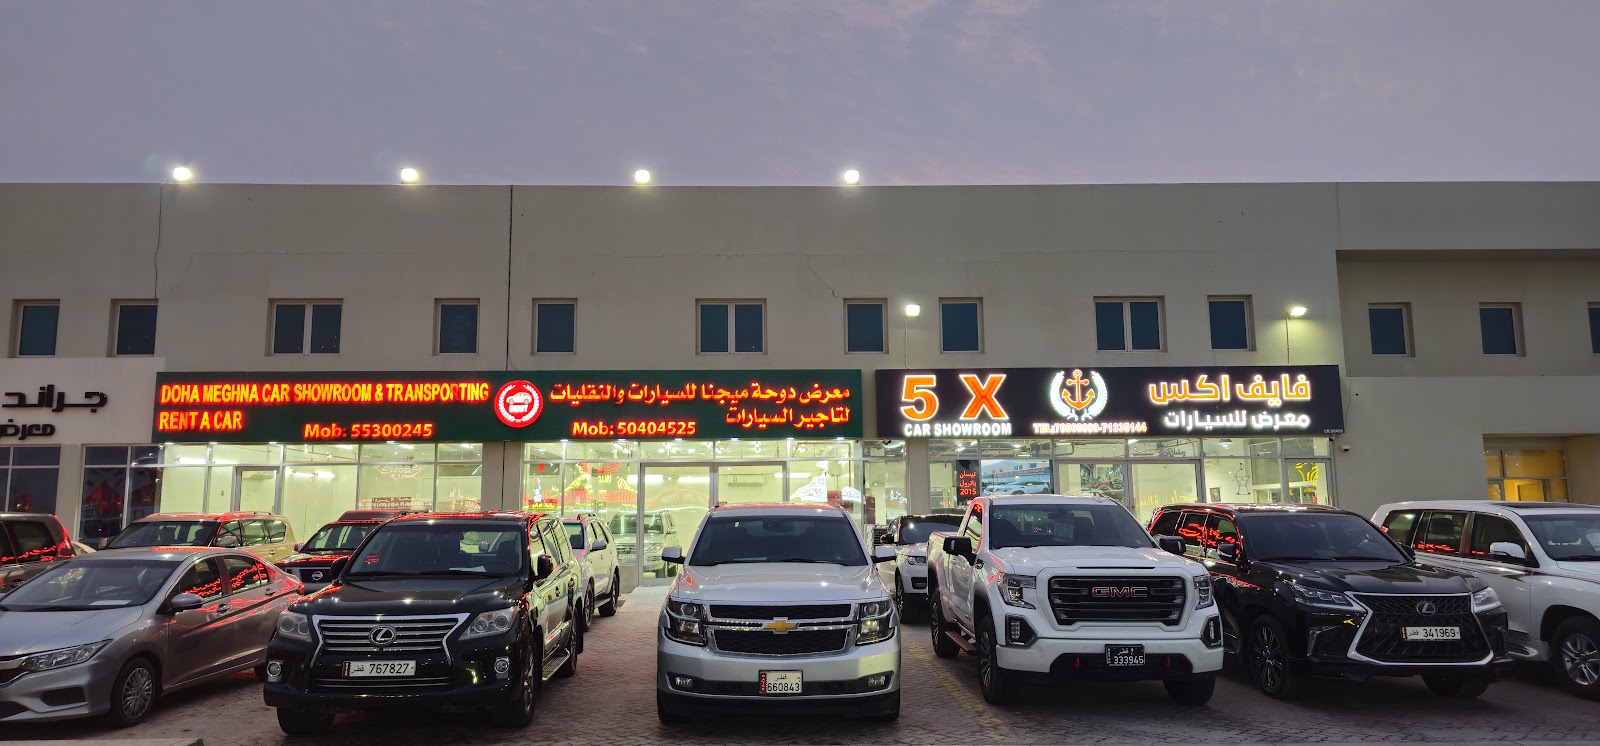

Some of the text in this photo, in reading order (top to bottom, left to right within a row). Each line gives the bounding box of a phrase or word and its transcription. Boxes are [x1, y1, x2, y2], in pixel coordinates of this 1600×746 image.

[161, 383, 489, 404] DOHA MEGHNA CAR SHOWROOM & TRANSPORTING
[549, 382, 851, 407] معرض دوحة ميجنا للسيارات والنقليات
[900, 373, 1010, 421] 5 X
[1148, 373, 1312, 406] فايف اكس
[1, 384, 108, 413] جراند
[158, 410, 243, 431] RENT A CAR
[725, 406, 851, 428] لتاجير السيارات
[1163, 411, 1311, 430] معرض للسيارات
[303, 423, 434, 439] Mob: 55300245
[571, 420, 697, 437] Mob: 50404525
[904, 422, 1012, 437] CAR SHOWROOM
[959, 488, 977, 496] 2015
[1091, 586, 1148, 598] GMC
[1423, 629, 1455, 637] 341969
[369, 663, 410, 674] 767827
[1113, 655, 1144, 665] 333945
[767, 683, 800, 691] 660843
